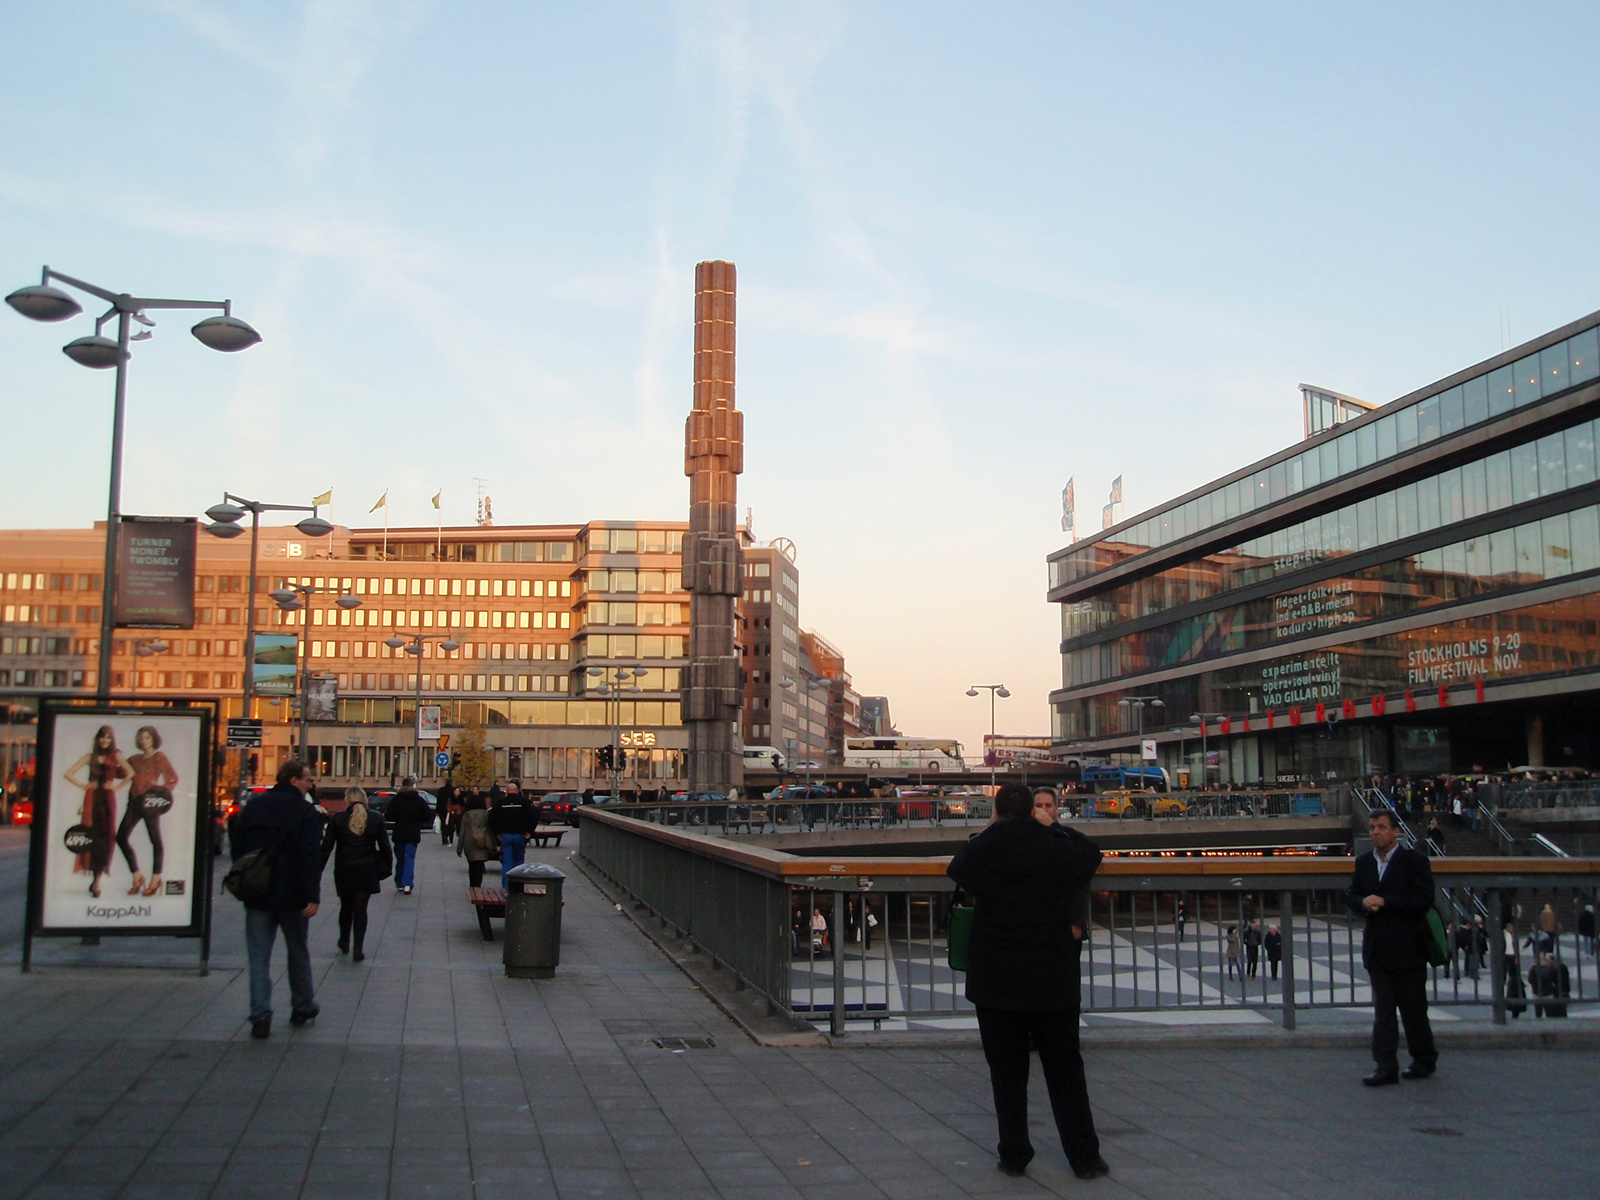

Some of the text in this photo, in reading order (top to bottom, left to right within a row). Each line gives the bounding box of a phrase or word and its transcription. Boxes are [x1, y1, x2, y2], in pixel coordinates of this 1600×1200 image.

[130, 547, 167, 556] MONET
[131, 538, 172, 547] TURNER
[130, 556, 179, 565] TWOMBLY
[1408, 633, 1520, 666] STOCKHOLMS 9-20
[1262, 652, 1339, 679] experimentellt
[1408, 653, 1522, 684] FILMFESTIVAL NOV.
[1263, 682, 1340, 706] VAD GILLAR DU?
[1199, 680, 1486, 736] KULTURHUSET
[620, 731, 656, 746] SEB
[87, 904, 152, 919] KappAhl
